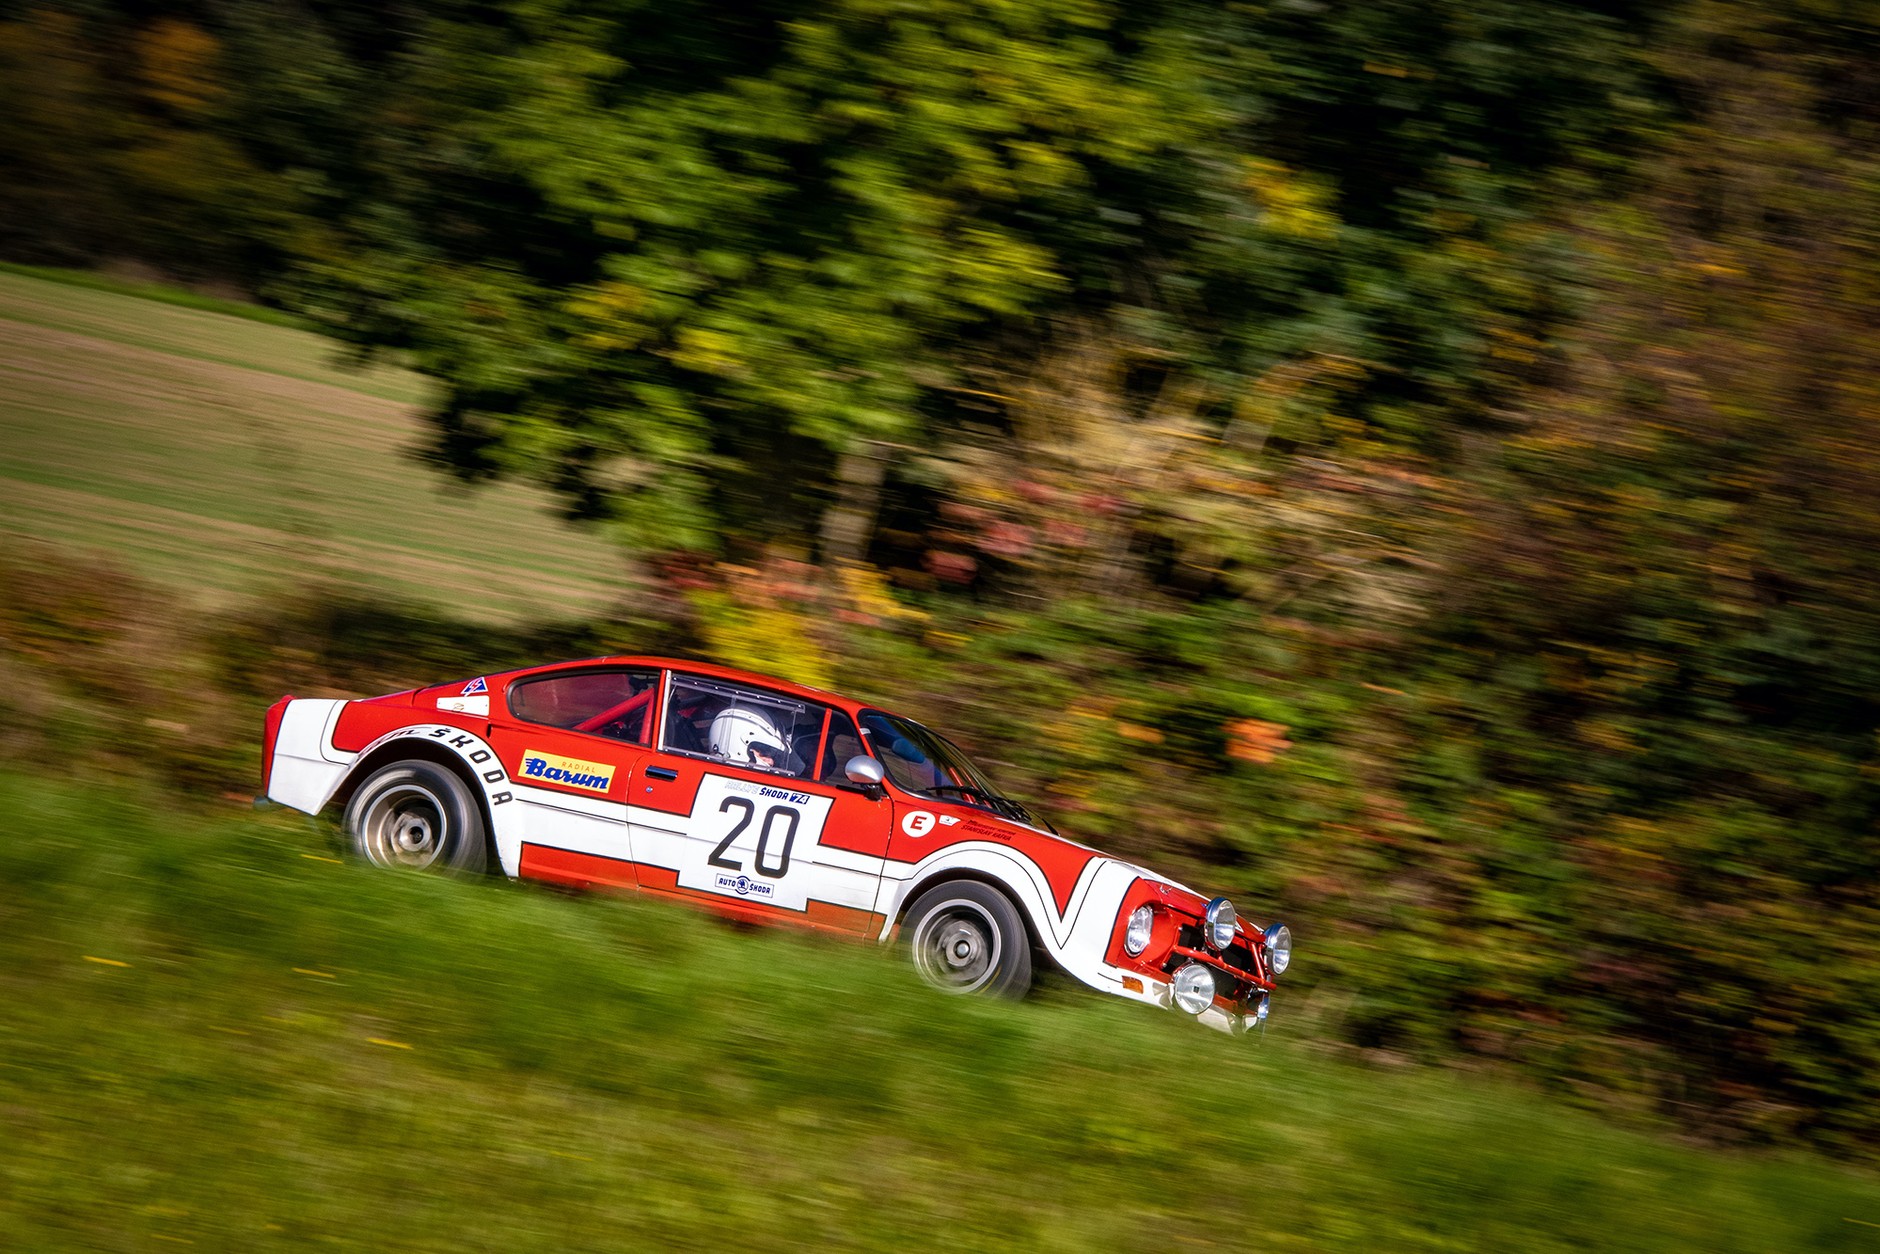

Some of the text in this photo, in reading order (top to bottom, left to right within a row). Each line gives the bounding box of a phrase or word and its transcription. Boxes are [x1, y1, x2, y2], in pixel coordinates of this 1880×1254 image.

[428, 727, 513, 806] ŠKODA
[525, 758, 610, 789] Barum
[561, 761, 596, 773] RADIAL
[759, 787, 789, 800] ŠKODA
[910, 815, 927, 831] E
[707, 795, 801, 879] 20
[718, 877, 771, 894] AUTO ŠKODA
